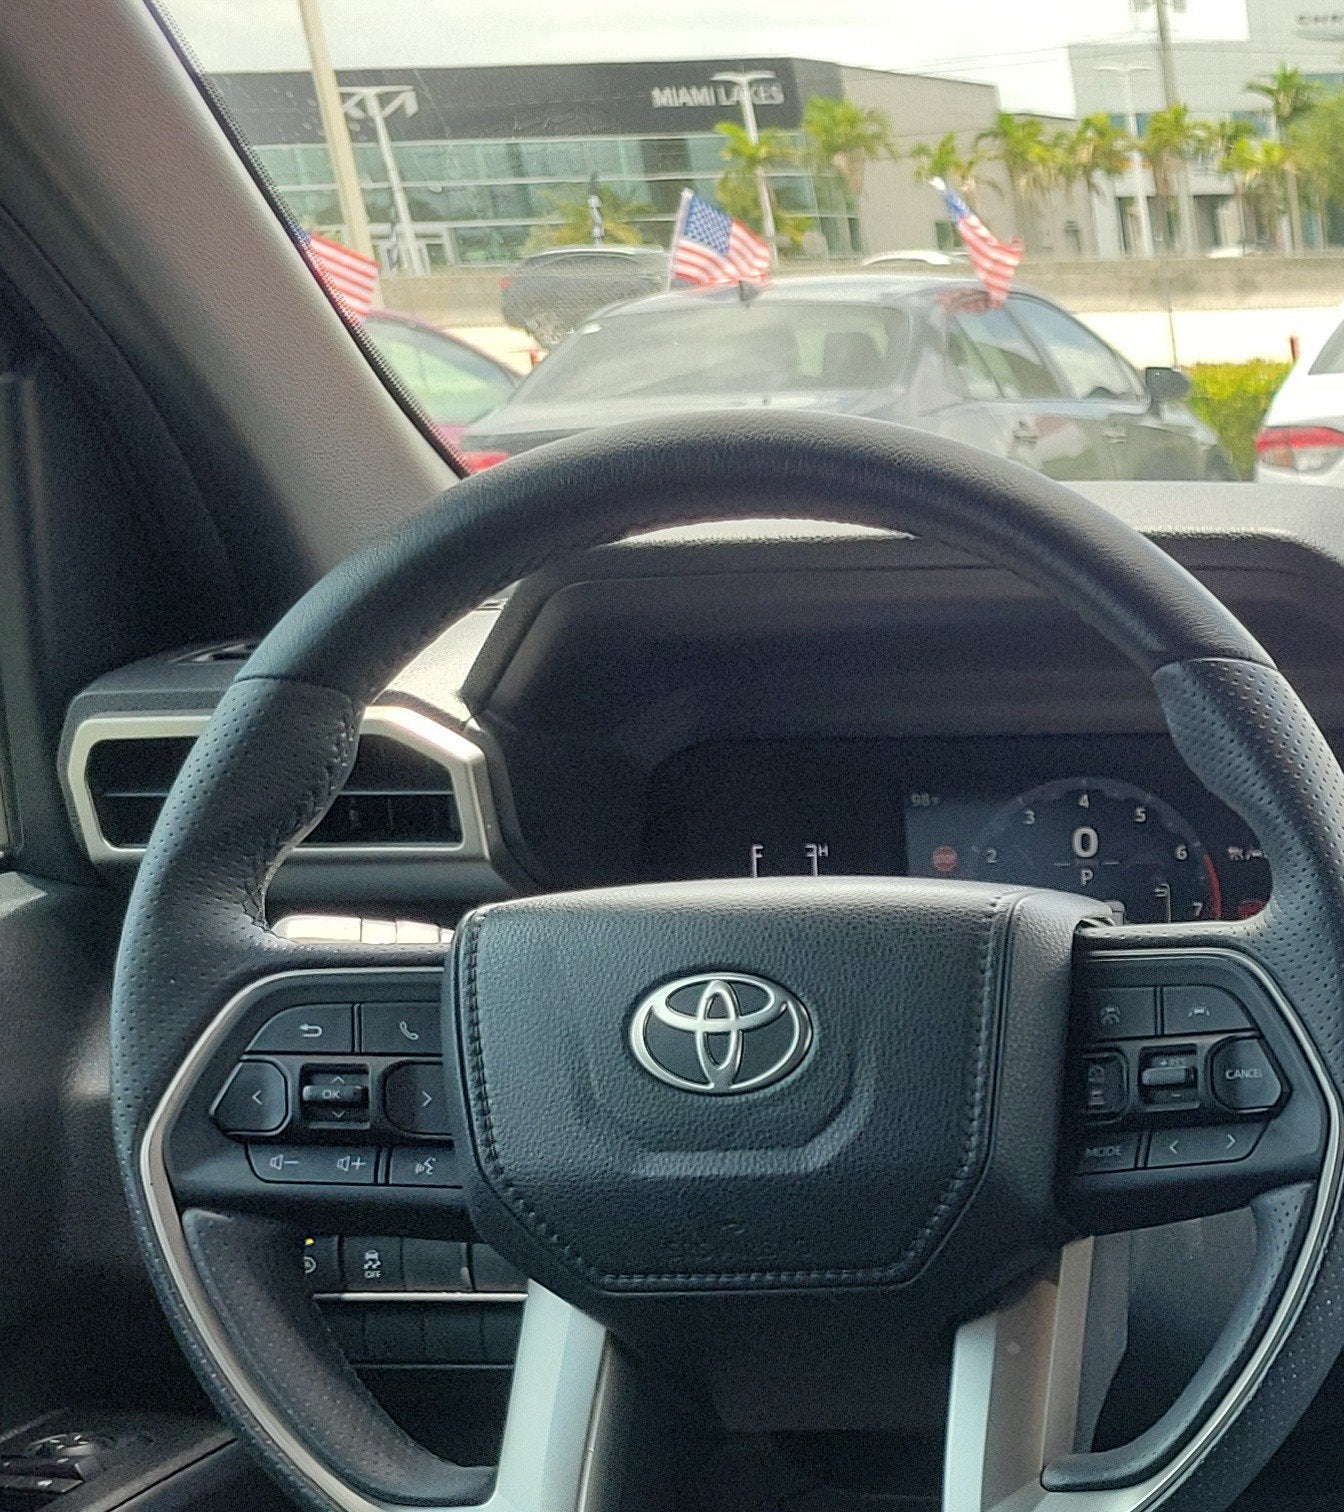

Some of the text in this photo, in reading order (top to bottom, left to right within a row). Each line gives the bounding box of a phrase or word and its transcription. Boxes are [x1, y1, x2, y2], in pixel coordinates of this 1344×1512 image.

[651, 86, 717, 108] MIAMI
[1078, 793, 1089, 809] 4
[1023, 809, 1036, 825] 3
[1133, 807, 1147, 823] 5
[1072, 826, 1099, 858] 0
[986, 848, 998, 864] 2
[1175, 844, 1188, 860] 6
[1080, 868, 1094, 886] P
[322, 1089, 341, 1099] OK
[1085, 1146, 1122, 1158] MODE
[364, 1270, 381, 1279] OFF
